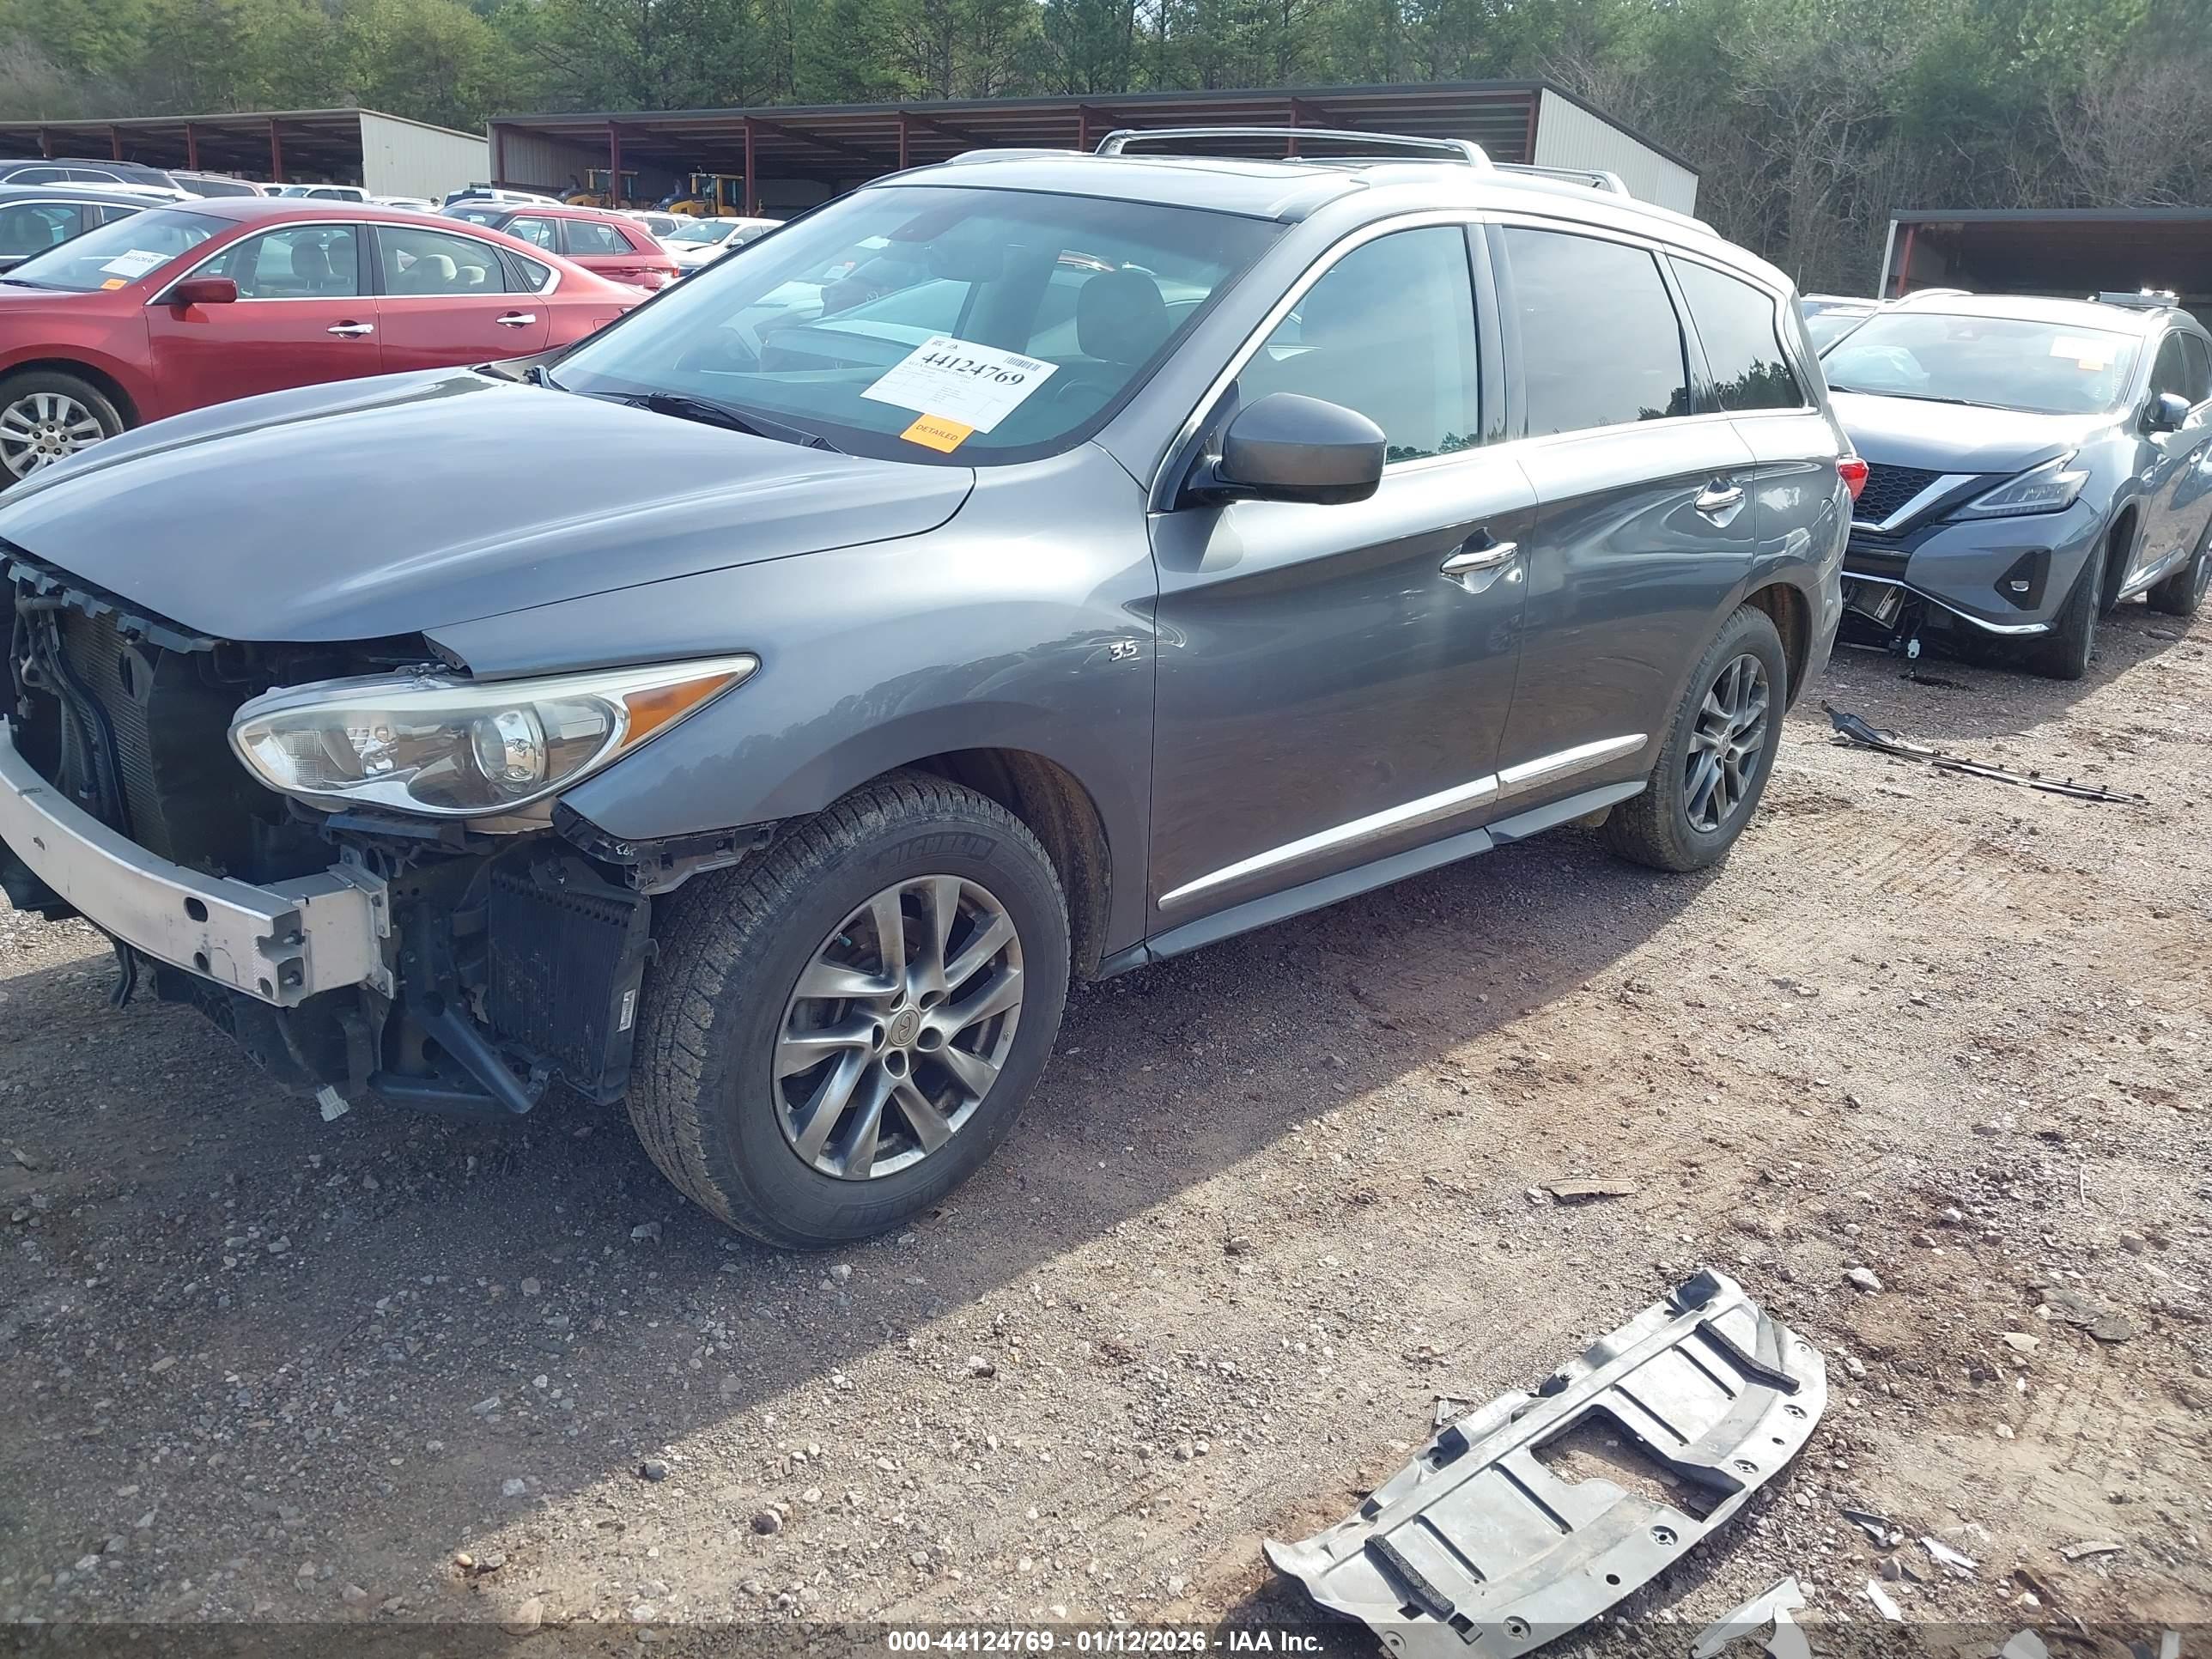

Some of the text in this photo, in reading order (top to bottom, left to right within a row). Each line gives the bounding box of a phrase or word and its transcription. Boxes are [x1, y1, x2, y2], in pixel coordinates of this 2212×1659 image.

[921, 352, 1024, 386] 44124769
[915, 424, 958, 441] DETAILED
[880, 835, 993, 865] MICHELIN
